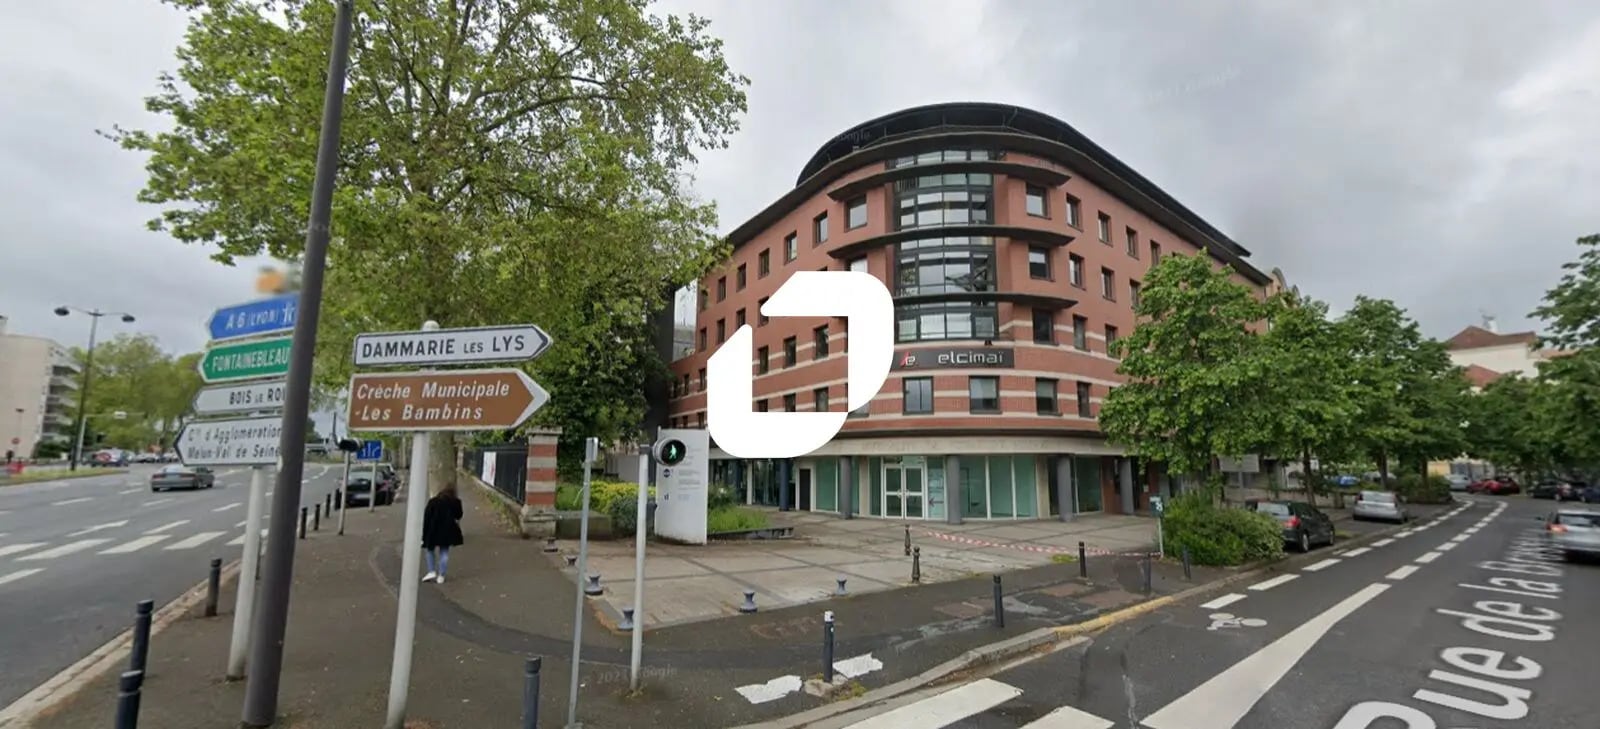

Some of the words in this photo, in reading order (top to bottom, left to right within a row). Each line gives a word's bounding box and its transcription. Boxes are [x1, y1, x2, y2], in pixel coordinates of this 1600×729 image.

[362, 338, 456, 358] DAMMARIE
[463, 341, 484, 354] LES
[492, 335, 525, 353] LYS
[229, 389, 252, 405] BOIS
[356, 383, 411, 400] Crèche
[421, 380, 510, 402] Municipale
[402, 402, 483, 421] Bambins
